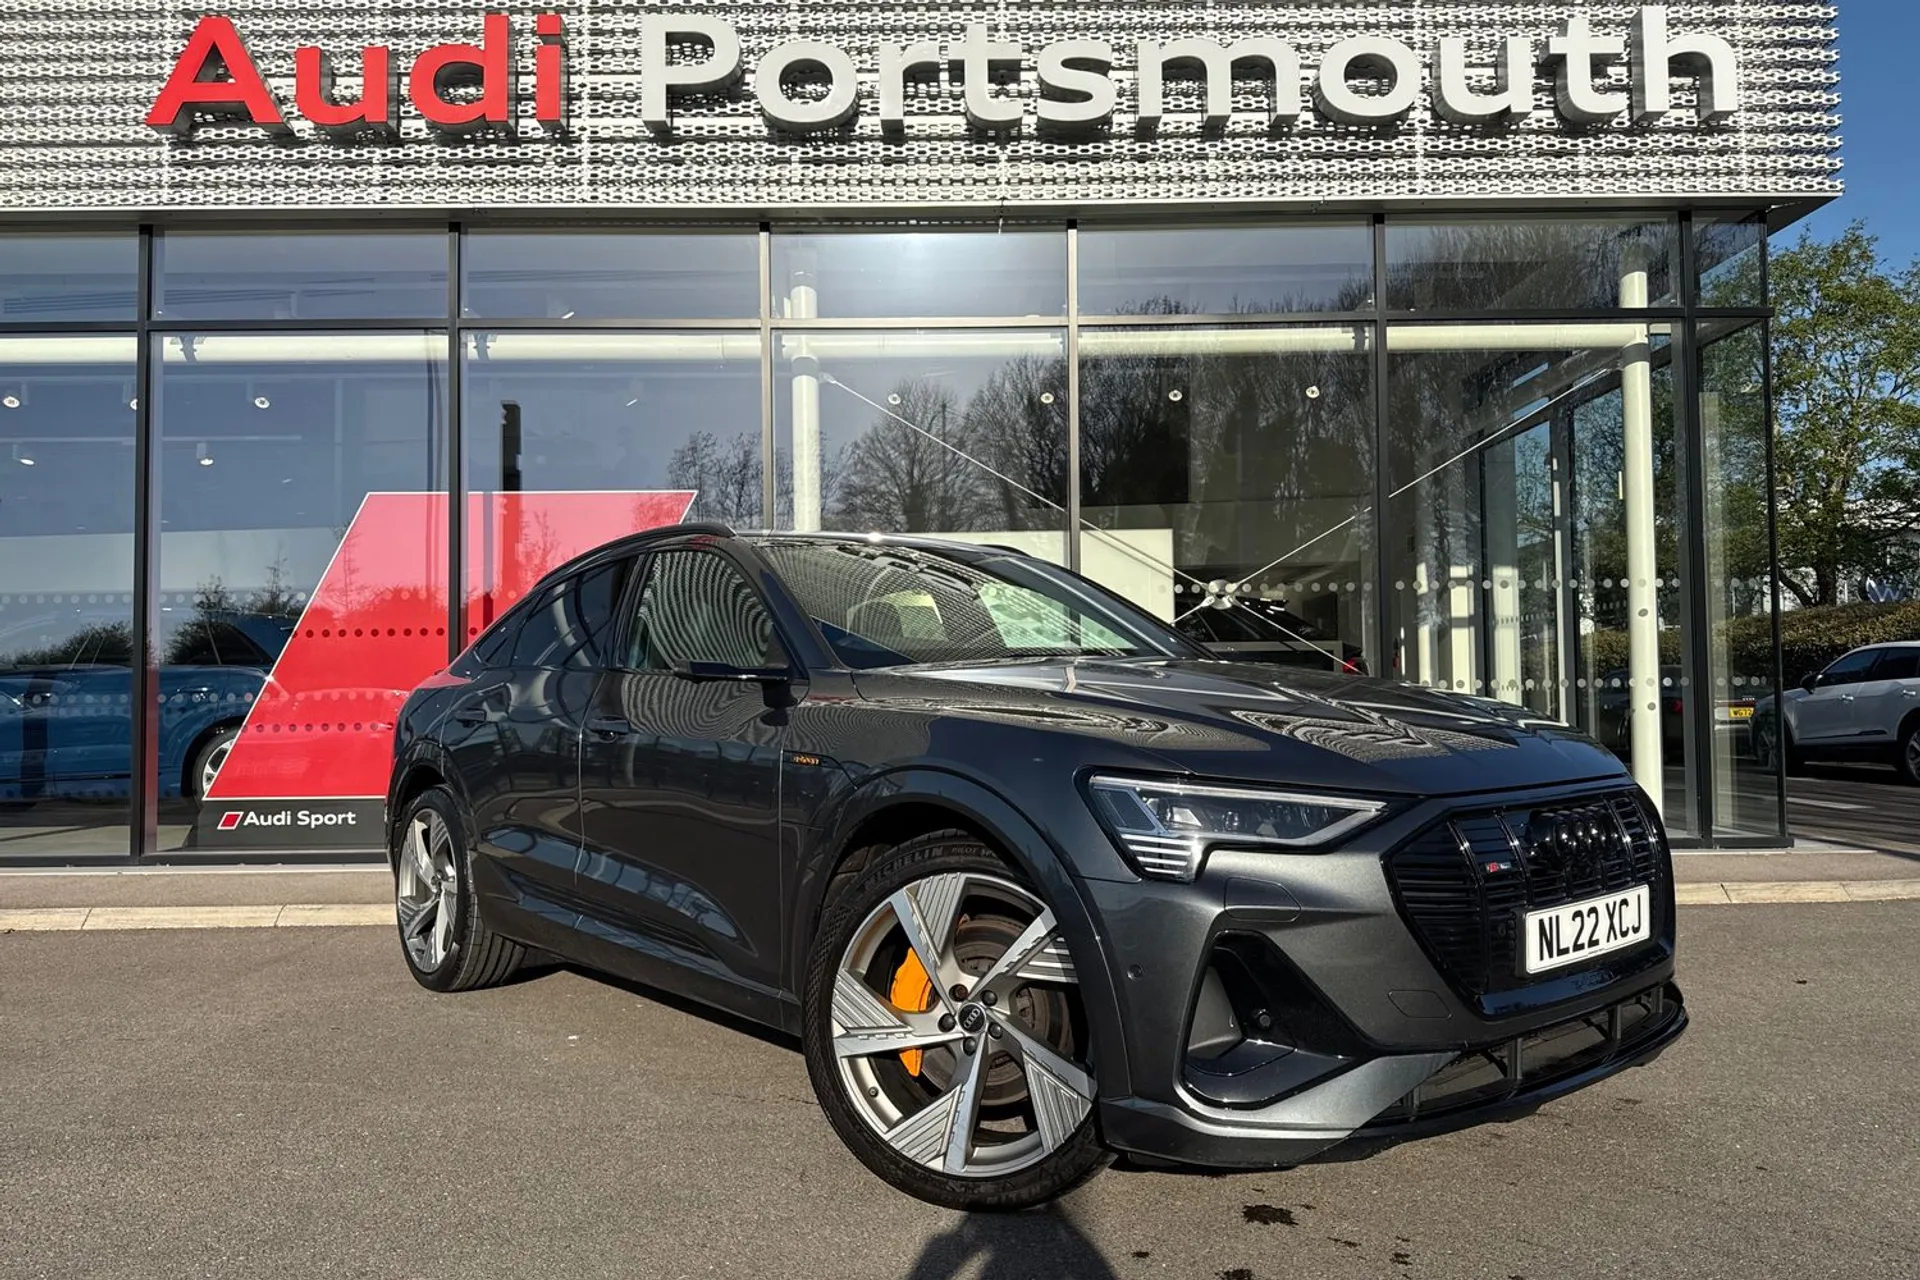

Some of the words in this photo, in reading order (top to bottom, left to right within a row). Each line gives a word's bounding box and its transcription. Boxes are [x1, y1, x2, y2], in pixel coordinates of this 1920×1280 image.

[146, 14, 563, 128] Audi
[642, 5, 1738, 128] Portsmouth
[243, 810, 291, 826] Audi
[297, 810, 357, 829] Sport
[1539, 906, 1600, 961] NL22
[1605, 894, 1642, 944] XCJ
